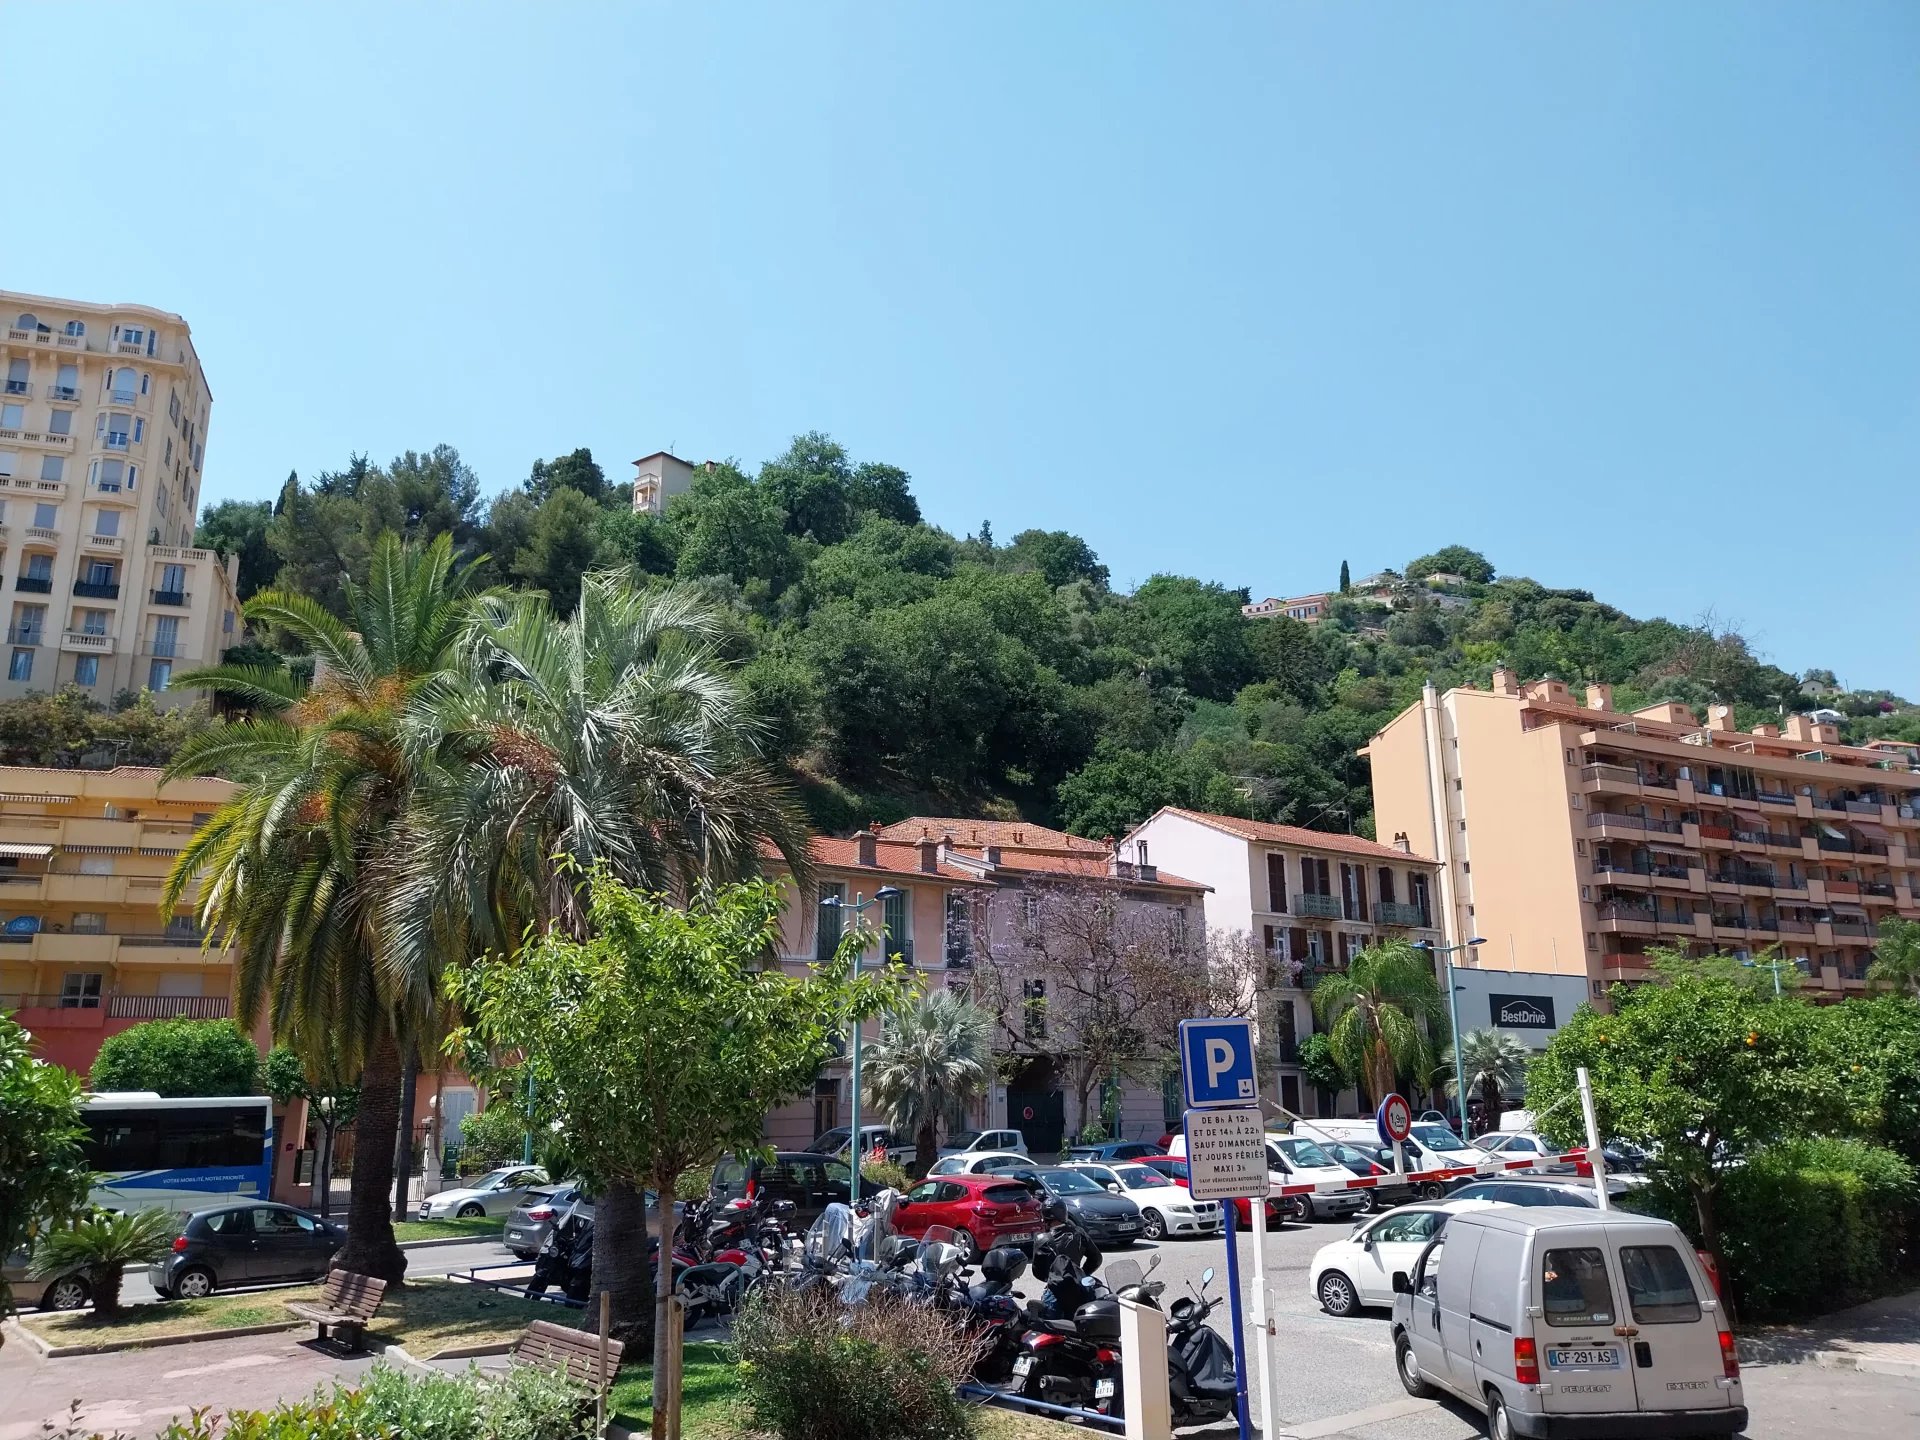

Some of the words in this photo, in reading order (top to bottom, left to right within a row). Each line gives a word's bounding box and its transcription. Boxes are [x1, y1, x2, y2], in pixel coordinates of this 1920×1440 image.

[1501, 1009, 1546, 1024] BestDrive
[1205, 1038, 1235, 1089] P
[1215, 1116, 1224, 1124] 8h
[1228, 1114, 1233, 1123] À
[1236, 1115, 1250, 1123] 12h
[1193, 1129, 1203, 1137] ET
[1206, 1128, 1217, 1137] DE
[1220, 1127, 1234, 1135] 14h
[1237, 1126, 1242, 1135] À
[1245, 1126, 1260, 1135] 22h
[1194, 1141, 1216, 1149] SAUF
[1218, 1138, 1261, 1148] DIMANCHE
[1192, 1154, 1203, 1162] ET
[1205, 1152, 1233, 1161] JOURS
[1235, 1149, 1265, 1159] FÉRIÉS
[1213, 1164, 1234, 1173] MAXI
[1201, 1186, 1238, 1194] STATIONNEMENT
[1557, 1351, 1611, 1363] CF-291-AS
[1561, 1385, 1612, 1393] PEUGEOT
[1666, 1381, 1709, 1391] EXPERT
